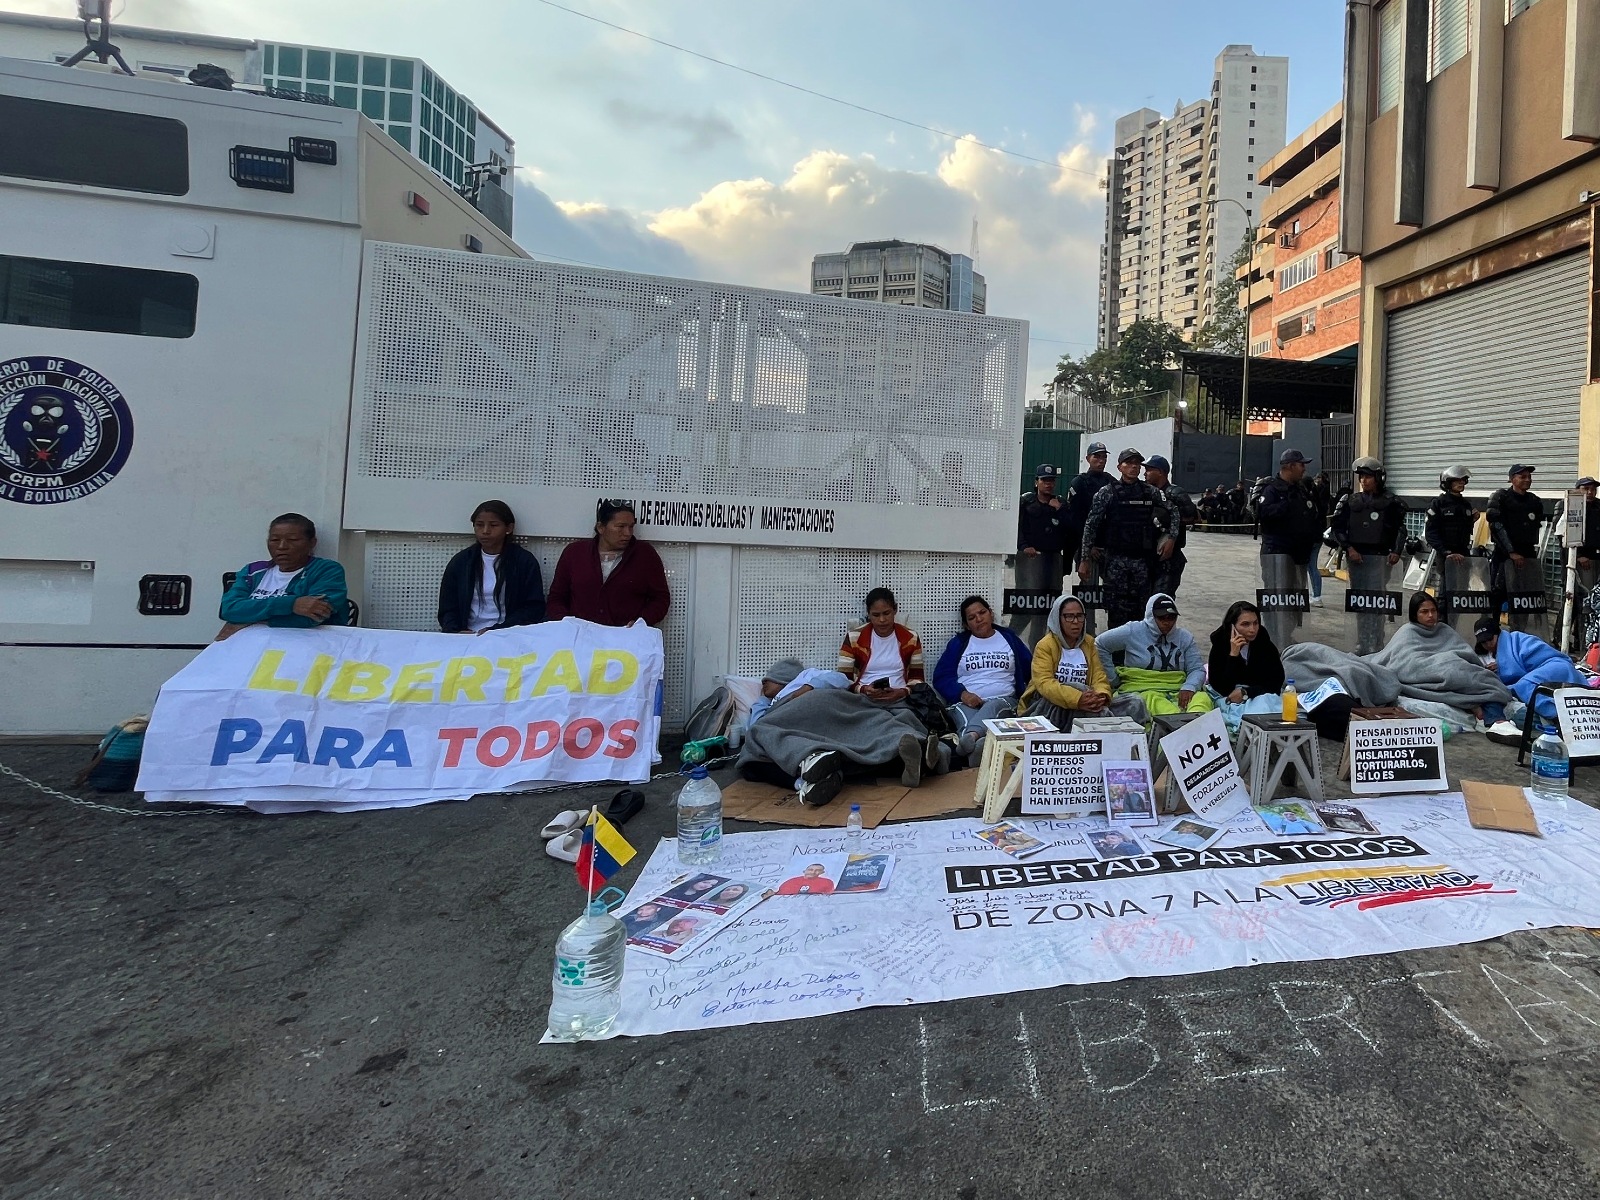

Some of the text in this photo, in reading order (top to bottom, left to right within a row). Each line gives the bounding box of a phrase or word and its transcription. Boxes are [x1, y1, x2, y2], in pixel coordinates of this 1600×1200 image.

[47, 359, 65, 372] DE
[0, 371, 113, 421] ECCIÓN NACIONAL
[9, 472, 64, 487] CRPM
[24, 471, 114, 502] BOLIVARIANA
[639, 500, 652, 524] DE
[653, 501, 704, 527] REUNIONES
[705, 500, 747, 529] PÚBLICAS
[748, 505, 755, 529] Y
[760, 505, 835, 533] MANIFESTACIONES
[1350, 594, 1397, 610] POLICÍA
[965, 654, 1010, 663] LOS PRESOS
[247, 648, 639, 703] LIBERTAD
[1355, 726, 1437, 738] PENSAR DISTINTO
[1572, 725, 1582, 733] SE
[210, 717, 641, 769] PARA TODOS
[1031, 743, 1099, 753] LAS MUERTES
[1355, 736, 1436, 748] NO ES UN DELITO.
[1031, 756, 1085, 766] DE PRESOS
[1356, 749, 1416, 761] AISLARLOS Y
[1030, 765, 1084, 775] POLÍTICOS
[1186, 755, 1229, 787] DESAPARICIONES
[1356, 759, 1428, 771] TORTURARLOS,
[1356, 769, 1395, 781] SÍ LO ES
[1030, 777, 1056, 786] BAJO
[1192, 768, 1235, 803] FORZADAS
[1030, 785, 1103, 796] DEL ESTADO SE
[1029, 795, 1106, 806] HAN INTENSIFIC
[1200, 782, 1238, 814] EN VENEZUELA
[953, 854, 1161, 889] LIBERTAD
[1167, 847, 1283, 869] PARA
[1280, 838, 1416, 862] TODOS
[953, 908, 1013, 931] DE
[1023, 899, 1148, 927] ZONA
[1151, 894, 1174, 912] 7
[1192, 890, 1221, 909] A
[1225, 885, 1284, 905] LA
[1284, 870, 1473, 901] LIBERTAD
